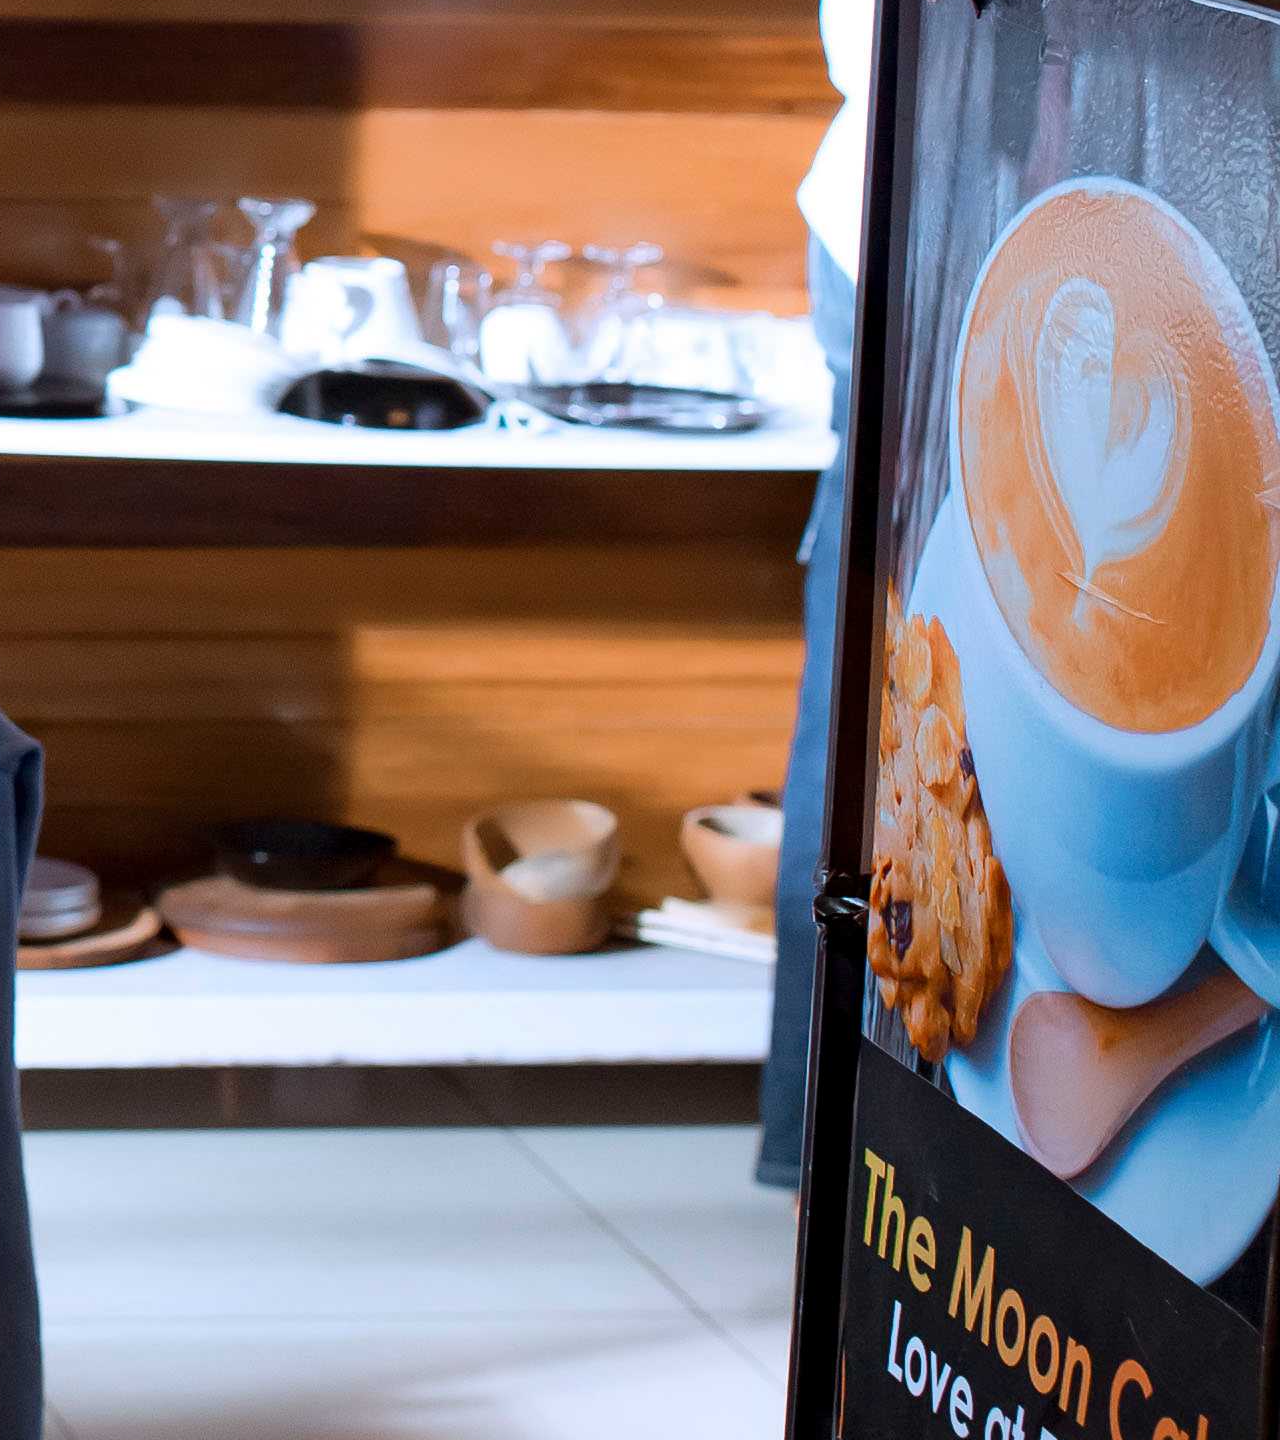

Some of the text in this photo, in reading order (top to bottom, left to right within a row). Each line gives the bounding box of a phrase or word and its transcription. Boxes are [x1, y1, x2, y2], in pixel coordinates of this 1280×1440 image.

[863, 1147, 937, 1293] The
[947, 1225, 1092, 1427] Moon
[886, 1299, 974, 1439] Love
